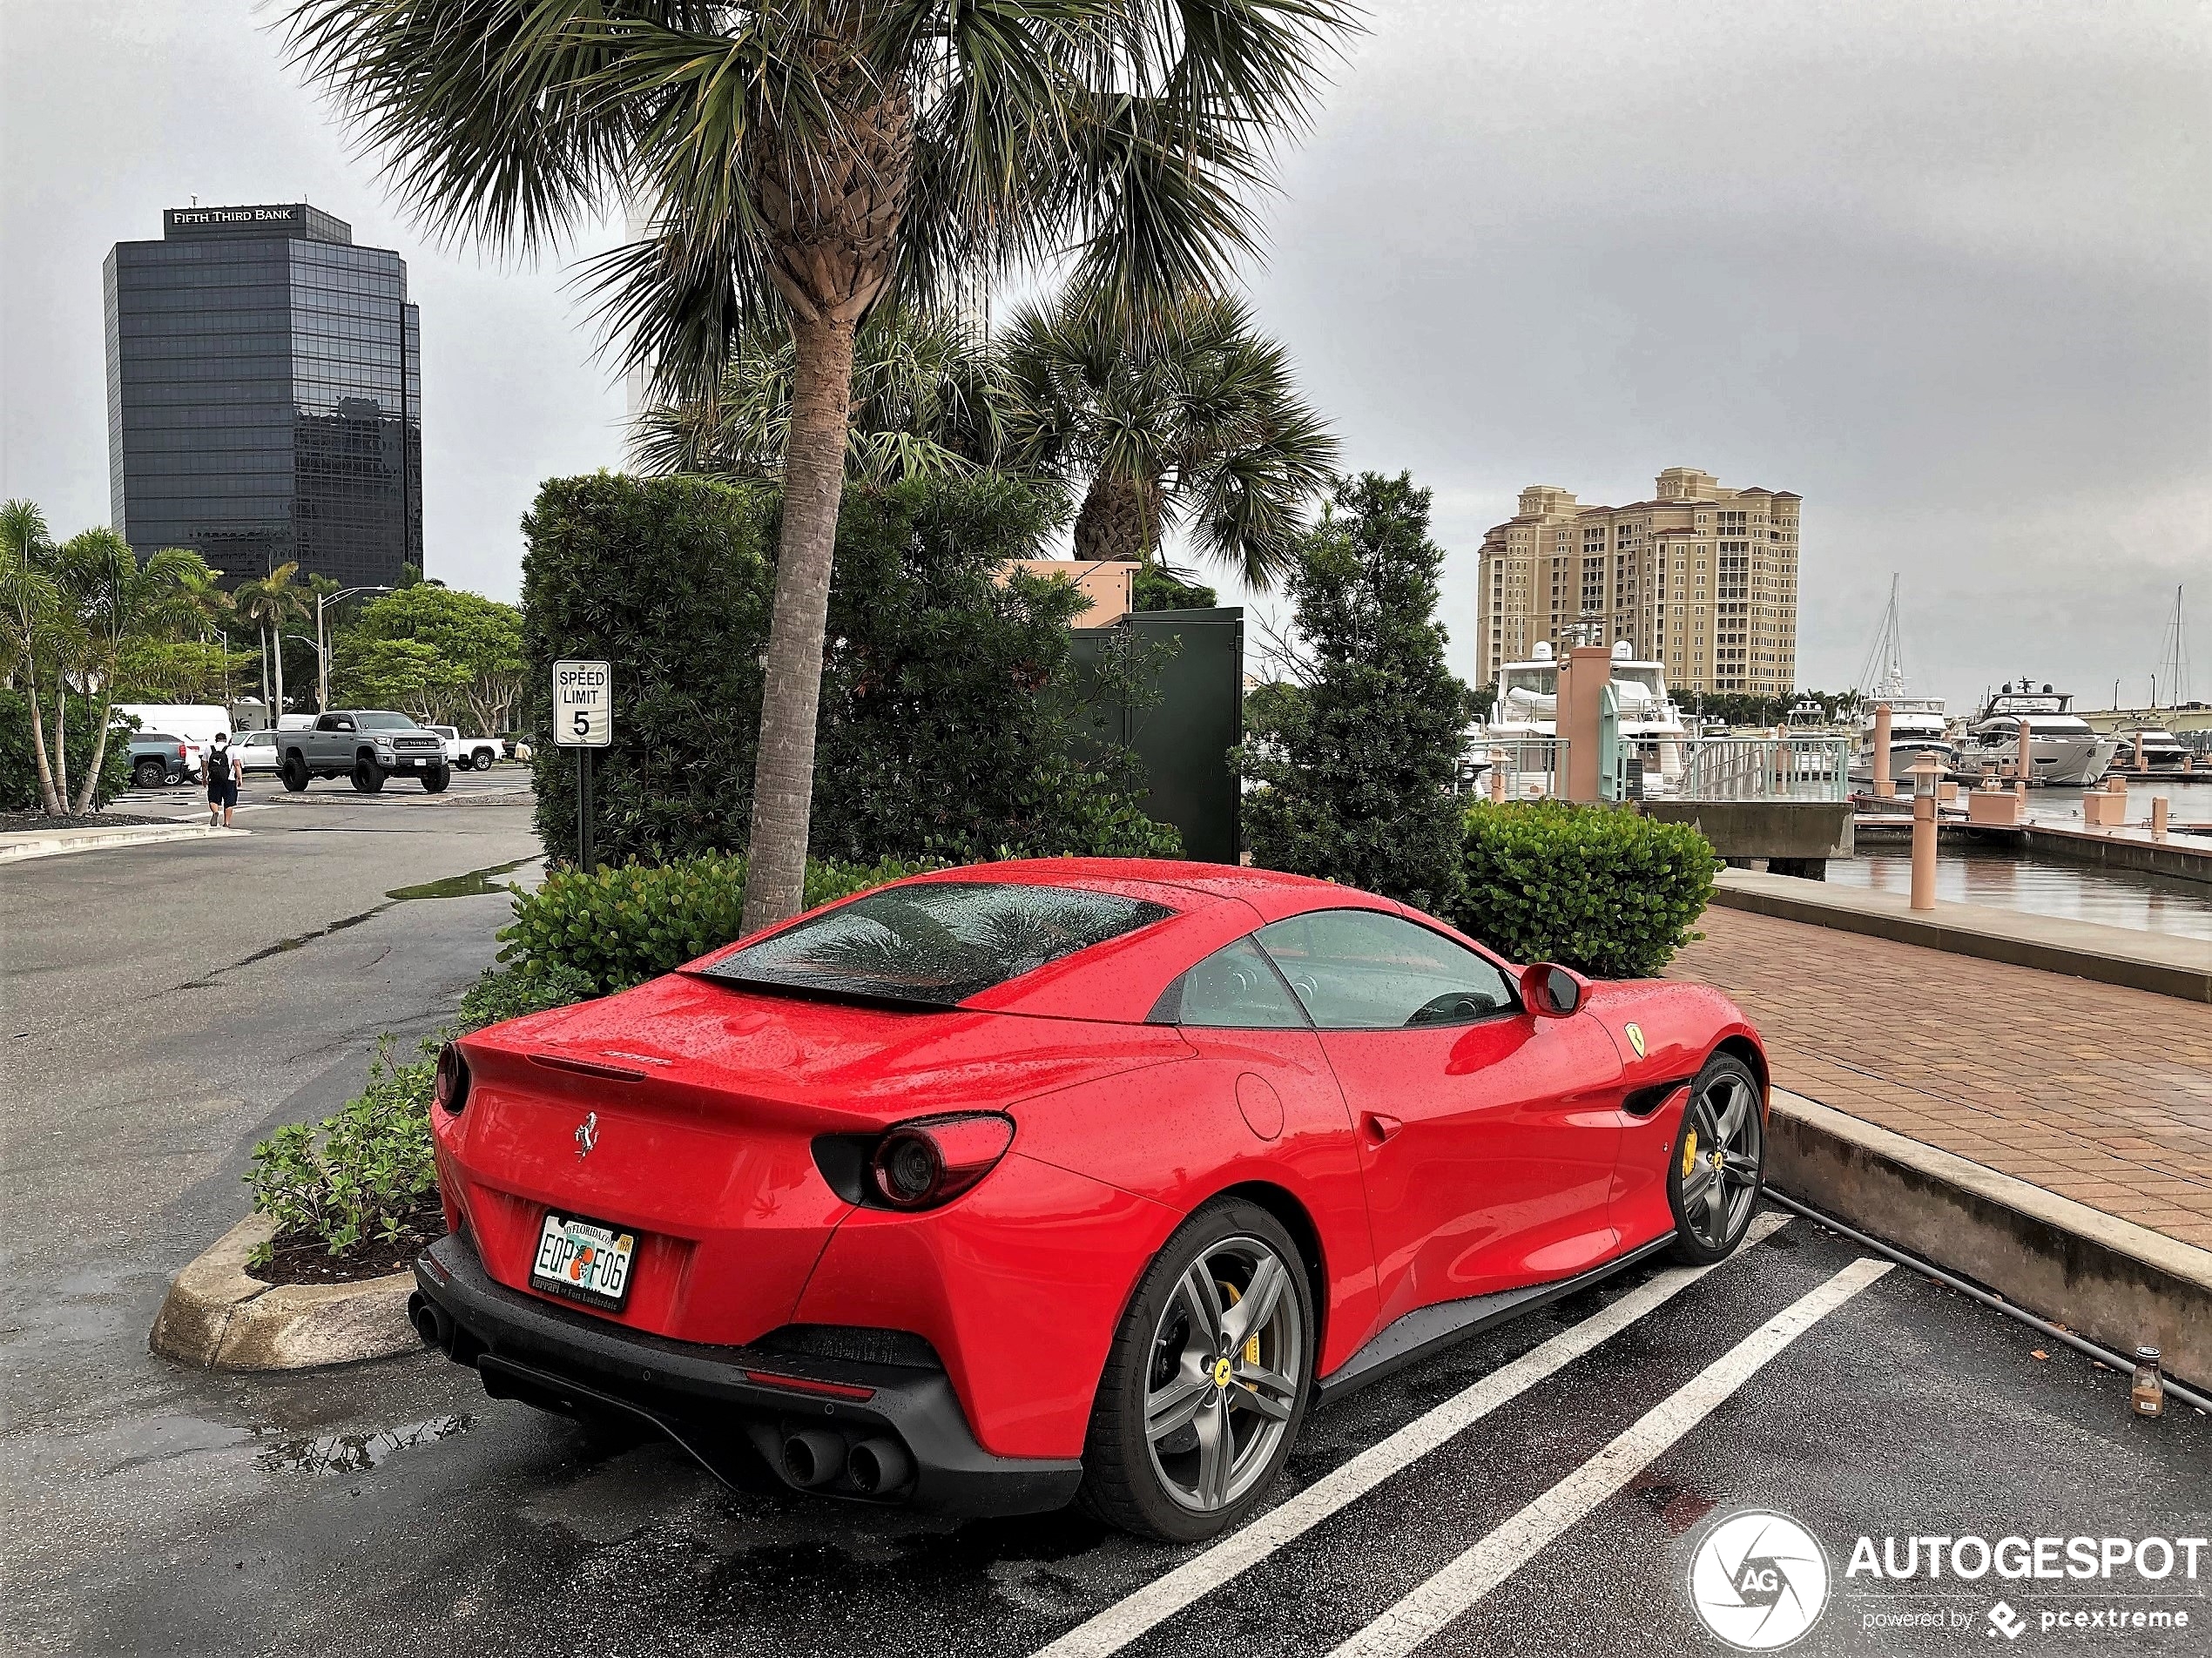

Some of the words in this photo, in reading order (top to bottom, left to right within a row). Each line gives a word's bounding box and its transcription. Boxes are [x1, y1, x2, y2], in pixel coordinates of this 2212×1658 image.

[173, 212, 209, 224] FIFTH
[212, 211, 252, 221] THIRD
[254, 209, 292, 220] BANK
[559, 671, 604, 686] SPEED
[563, 690, 598, 704] LIMIT
[572, 711, 590, 736] 5
[590, 1248, 626, 1291] F06
[532, 1276, 560, 1294] Ferrari
[582, 1292, 618, 1311] Lauderdale
